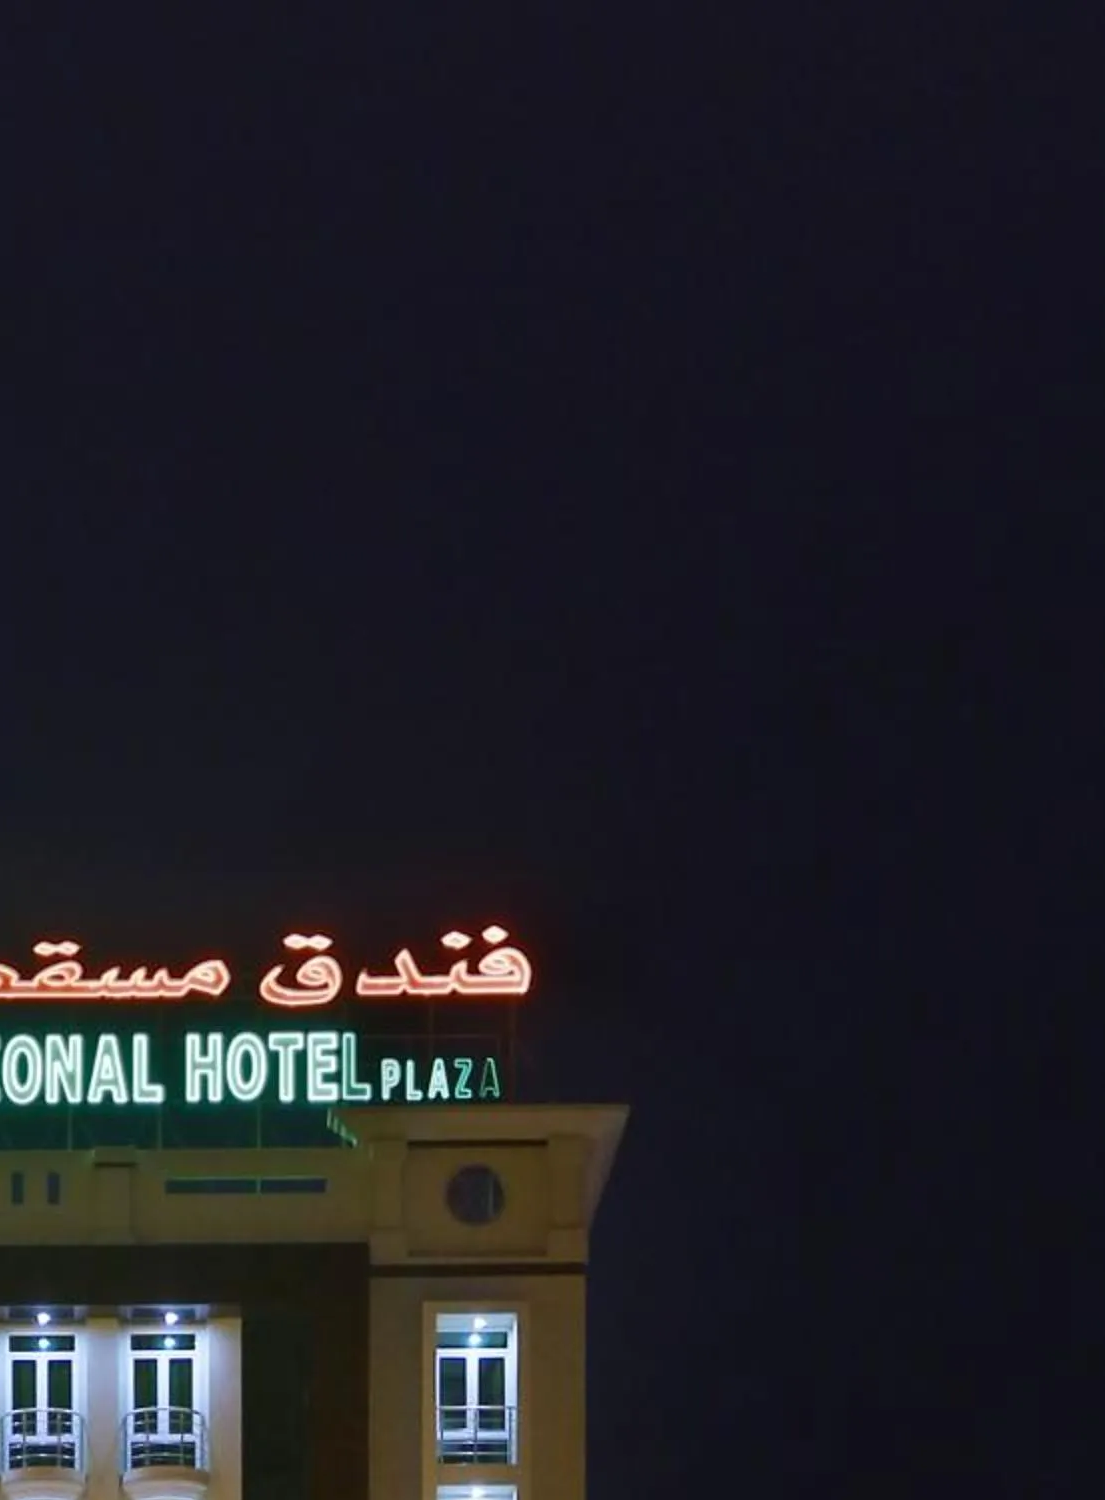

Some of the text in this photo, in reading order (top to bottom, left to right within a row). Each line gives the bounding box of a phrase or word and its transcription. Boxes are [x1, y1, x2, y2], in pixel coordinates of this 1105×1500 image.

[259, 924, 532, 1006] فندق
[185, 1032, 372, 1104] HOTEL
[381, 1058, 502, 1101] PLAZA
